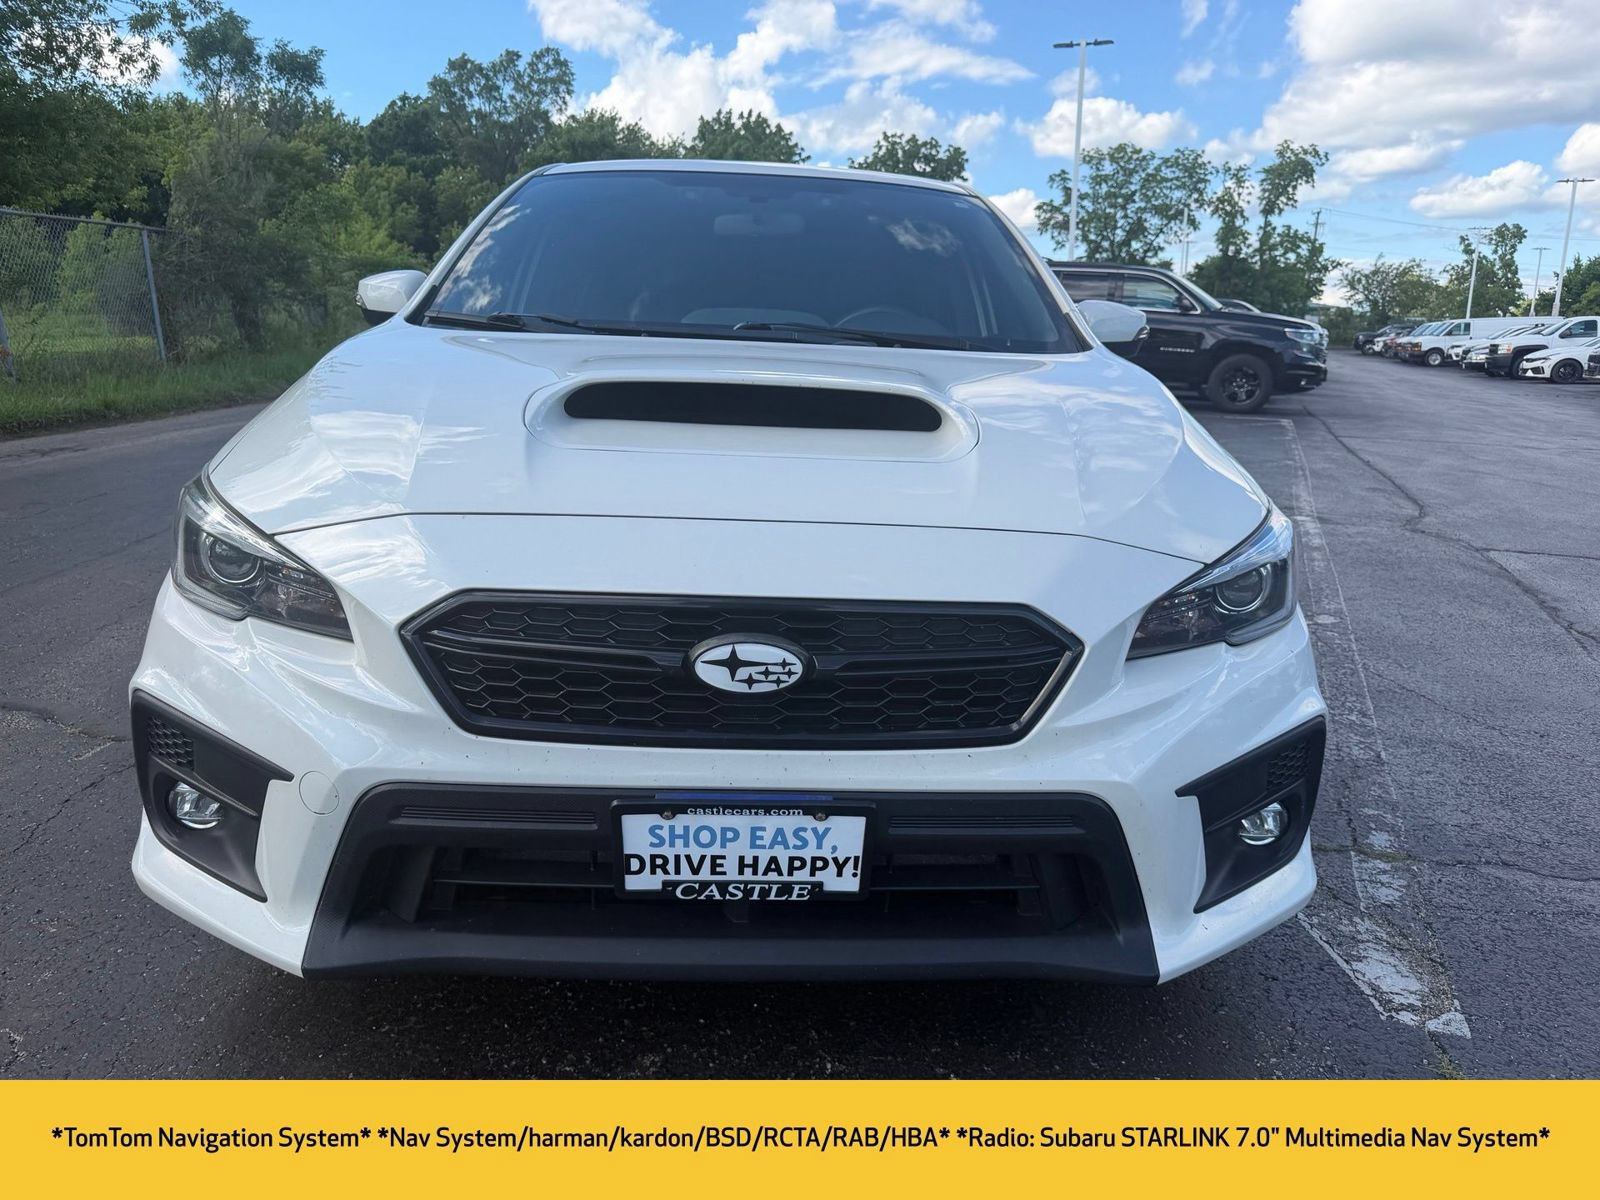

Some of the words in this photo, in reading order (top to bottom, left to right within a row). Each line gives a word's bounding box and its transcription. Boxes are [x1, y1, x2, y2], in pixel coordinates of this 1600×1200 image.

[687, 806, 803, 816] castlecars.com
[648, 824, 740, 849] SHOP
[749, 826, 838, 855] EASY,
[624, 853, 727, 876] DRIVE
[738, 855, 860, 878] HAPPY!
[674, 882, 811, 900] CASTLE
